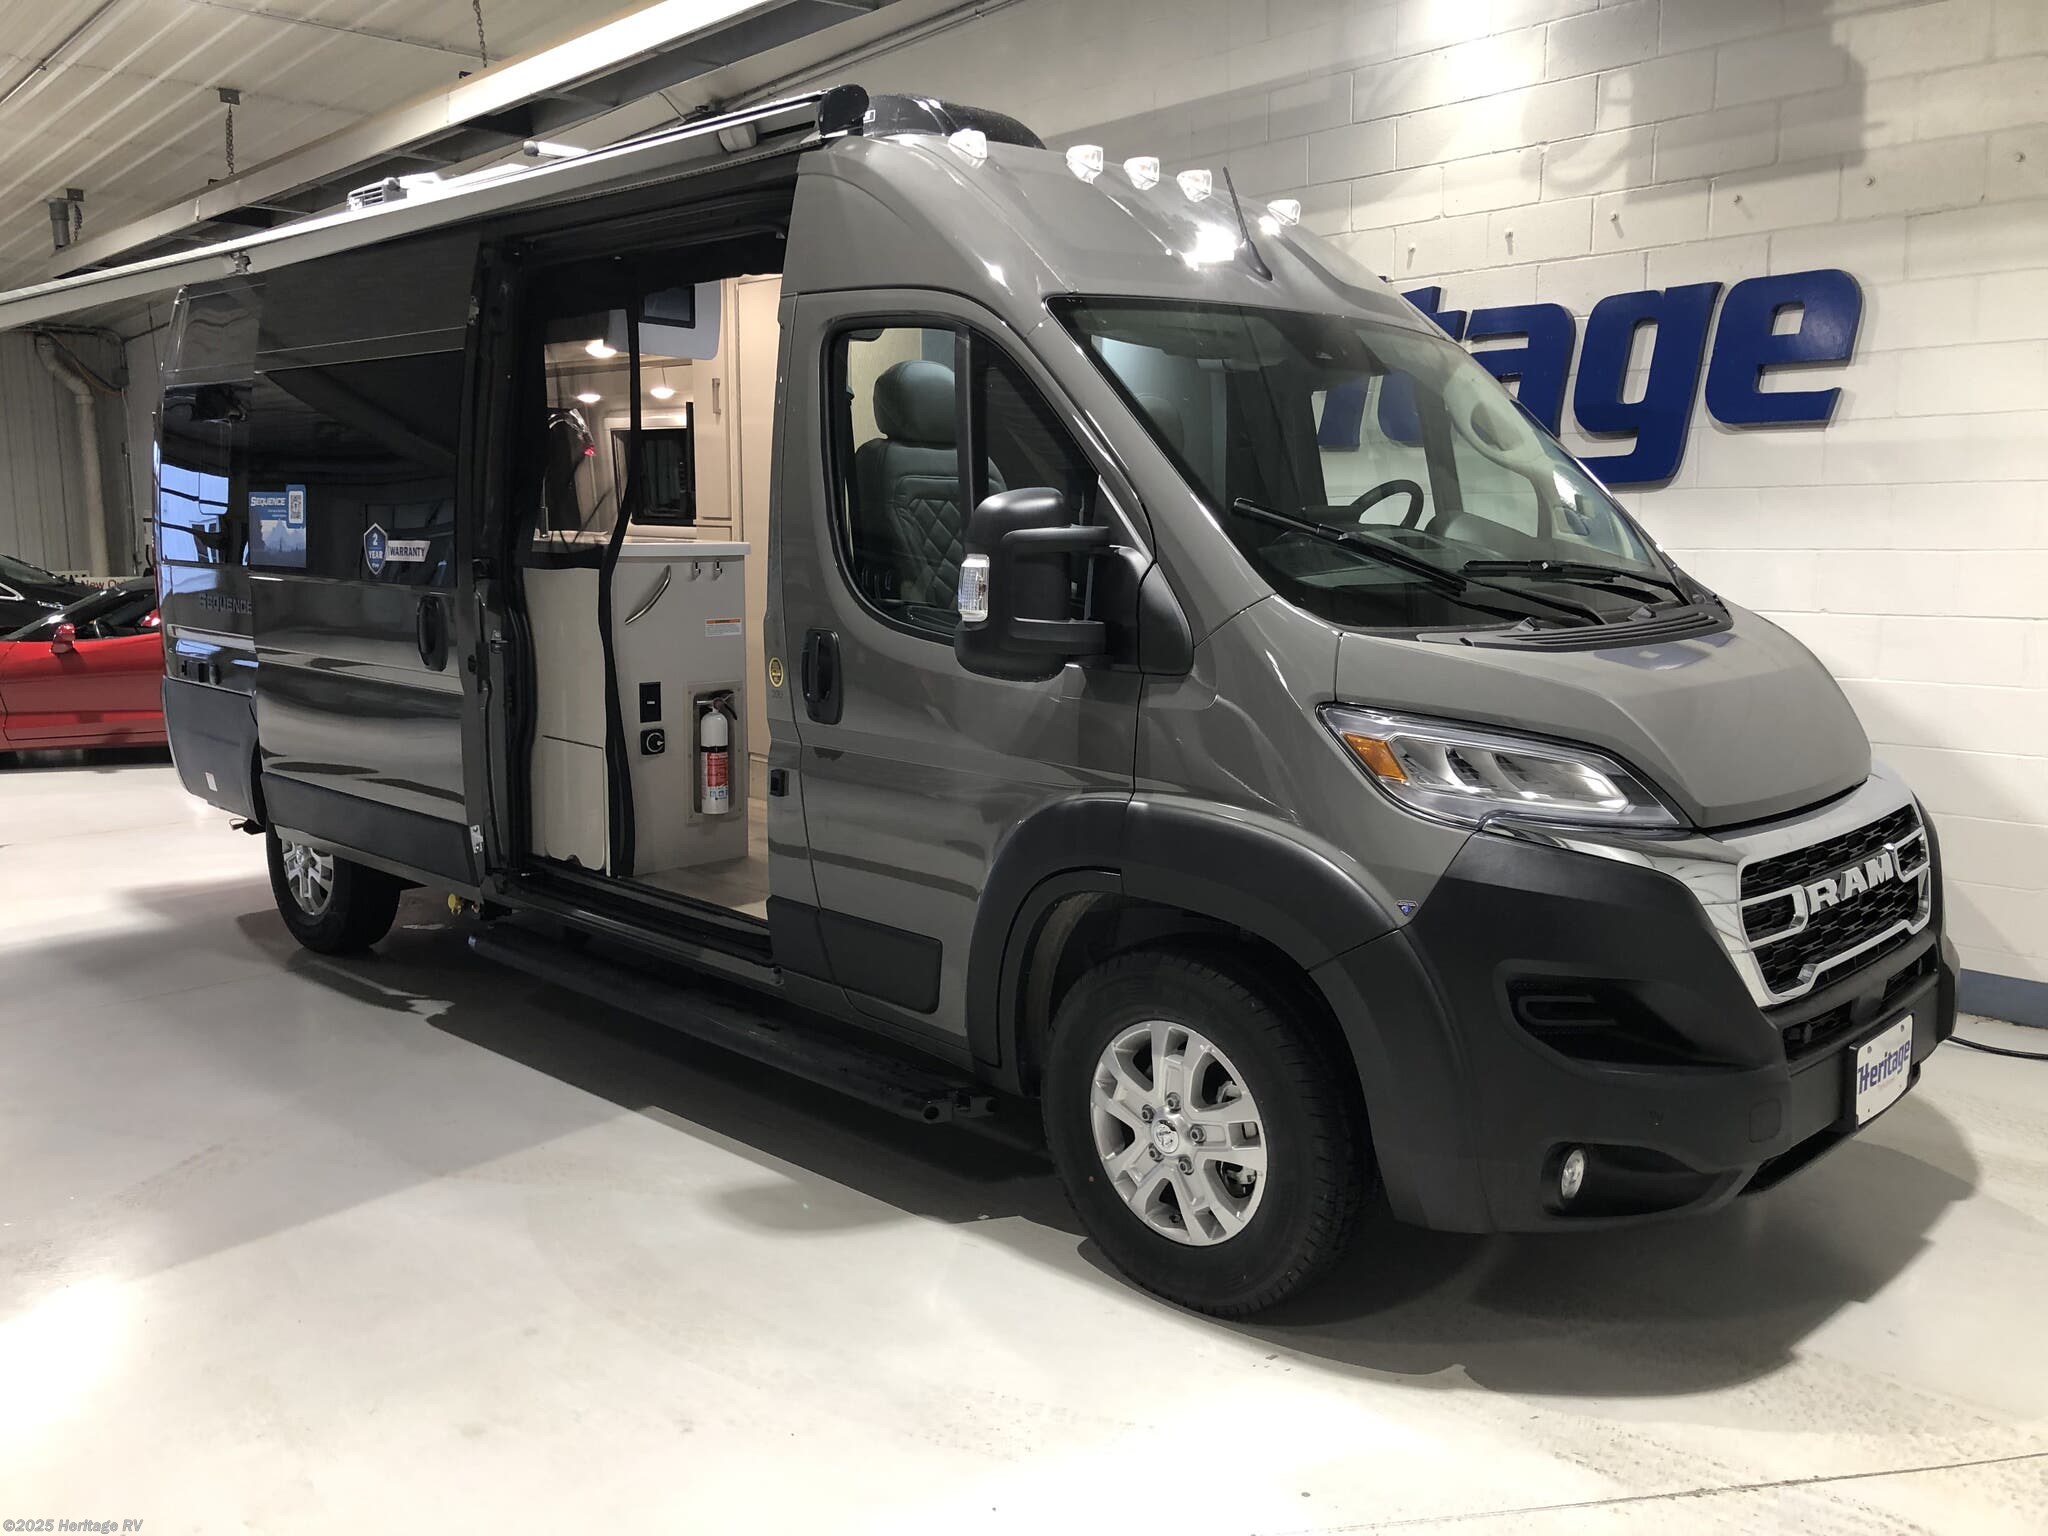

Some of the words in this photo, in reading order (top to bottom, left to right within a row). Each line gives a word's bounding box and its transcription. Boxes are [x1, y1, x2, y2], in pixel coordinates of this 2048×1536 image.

[372, 532, 379, 546] 2
[368, 550, 384, 559] YEAR
[390, 546, 426, 557] WARRANTY
[1806, 852, 1894, 915] RAM
[1857, 1039, 1911, 1095] Heritage
